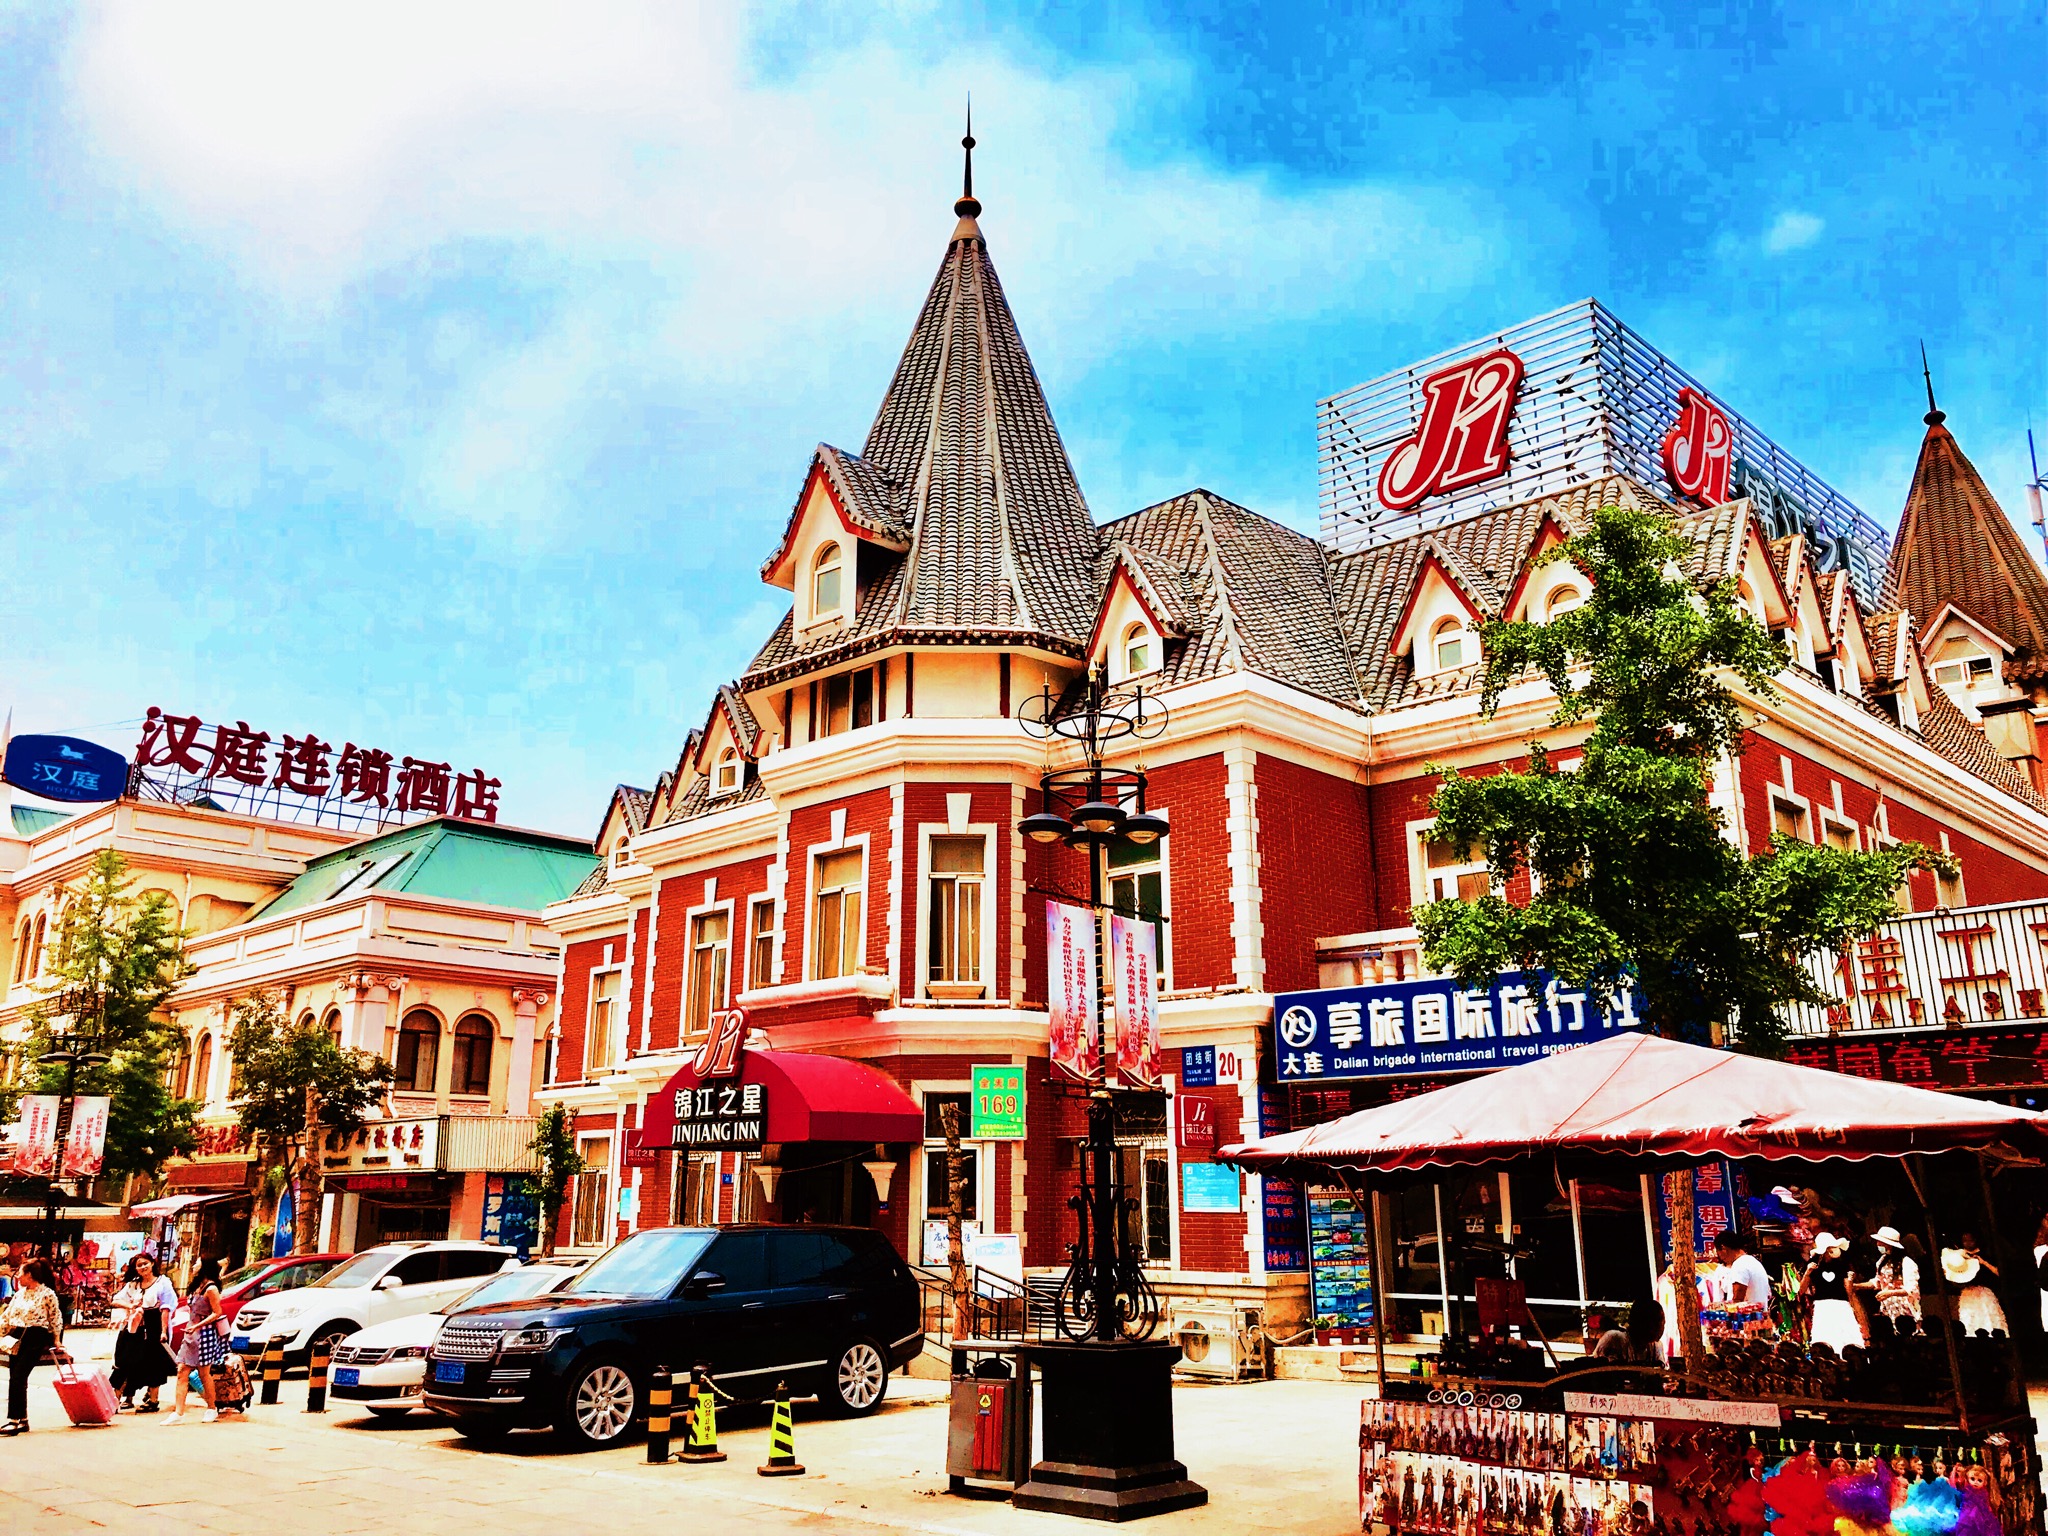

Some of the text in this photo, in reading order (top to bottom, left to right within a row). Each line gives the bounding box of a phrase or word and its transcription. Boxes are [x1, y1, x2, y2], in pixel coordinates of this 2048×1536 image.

[32, 762, 101, 791] 汉庭
[136, 706, 502, 823] 汉庭连锁酒店
[46, 785, 81, 796] HOTEL
[1327, 973, 1642, 1049] 享旅国际旅行社
[1185, 1048, 1213, 1066] 团结街
[1219, 1052, 1235, 1076] 20
[1283, 1053, 1324, 1075] 大连
[1333, 1041, 1588, 1070] Dalian brigade international travel agenc
[674, 1084, 762, 1120] 锦江之星
[979, 1094, 1018, 1115] 169
[672, 1121, 760, 1145] JINJIANG INN
[1185, 1123, 1214, 1134] 锦江之星
